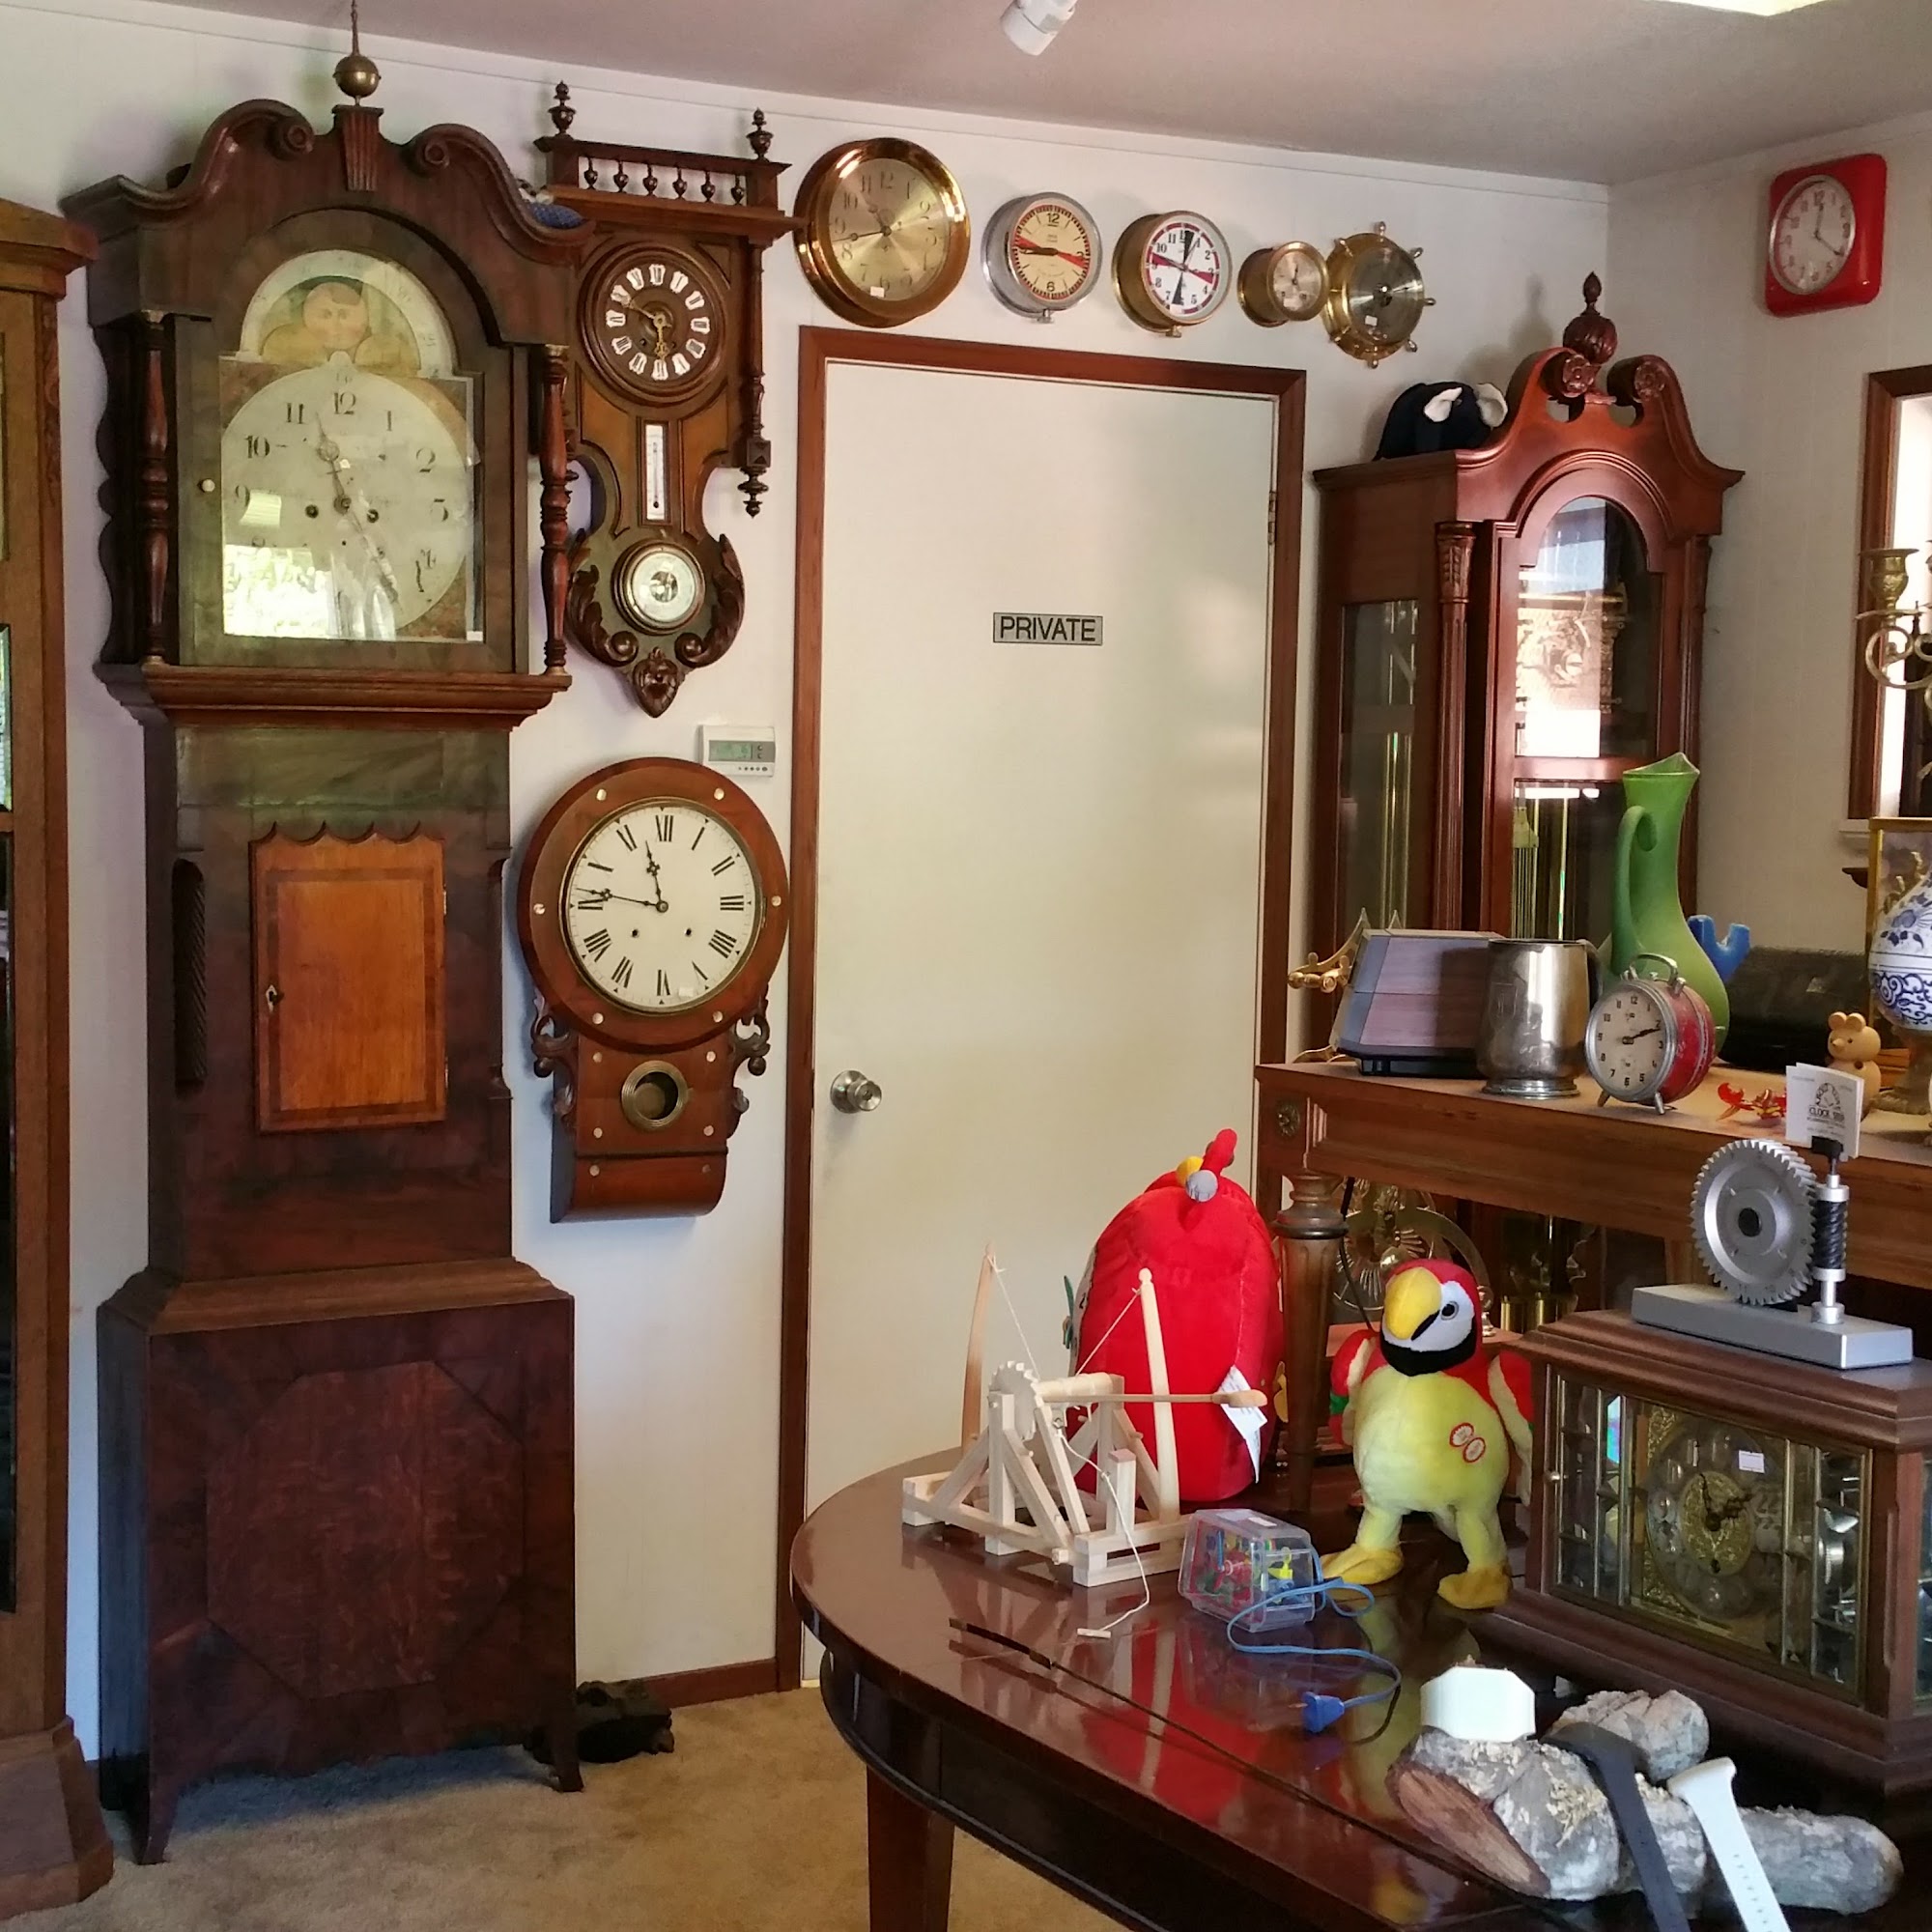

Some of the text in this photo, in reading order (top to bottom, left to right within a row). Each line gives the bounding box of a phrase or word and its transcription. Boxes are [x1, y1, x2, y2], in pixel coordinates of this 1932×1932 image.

[861, 175, 871, 193] 11
[880, 170, 895, 190] 12
[906, 181, 913, 200] 1
[1814, 190, 1826, 207] 12
[843, 192, 859, 210] 10
[920, 200, 931, 220] 2
[834, 216, 846, 235] 9
[1047, 213, 1061, 224] 12
[924, 226, 938, 246] 3
[1167, 233, 1177, 244] 11
[841, 242, 854, 261] 8
[1156, 242, 1168, 253] 10
[1205, 250, 1211, 260] 2
[860, 263, 869, 282] 7
[899, 267, 913, 288] 5
[1154, 276, 1162, 288] 8
[879, 275, 891, 293] 6
[1046, 281, 1056, 293] 6
[1203, 285, 1208, 295] 4
[1165, 290, 1171, 300] 7
[1190, 294, 1198, 304] 5
[286, 402, 305, 425] 11
[333, 392, 357, 416] 12
[384, 409, 393, 433] 1
[244, 435, 271, 460] 10
[415, 447, 437, 473] 2
[1000, 615, 1096, 642] PRIVATE
[653, 814, 674, 843] XII
[690, 826, 706, 851] I
[710, 856, 736, 877] II
[720, 895, 745, 912] III
[582, 927, 612, 963] VIII
[708, 929, 738, 959] IIII
[611, 956, 634, 989] VII
[656, 969, 671, 997] VI
[1631, 996, 1638, 1006] 12
[1659, 1040, 1663, 1049] 3
[1609, 1068, 1616, 1079] 7
[1624, 1077, 1631, 1087] 6
[1638, 1073, 1646, 1083] 5
